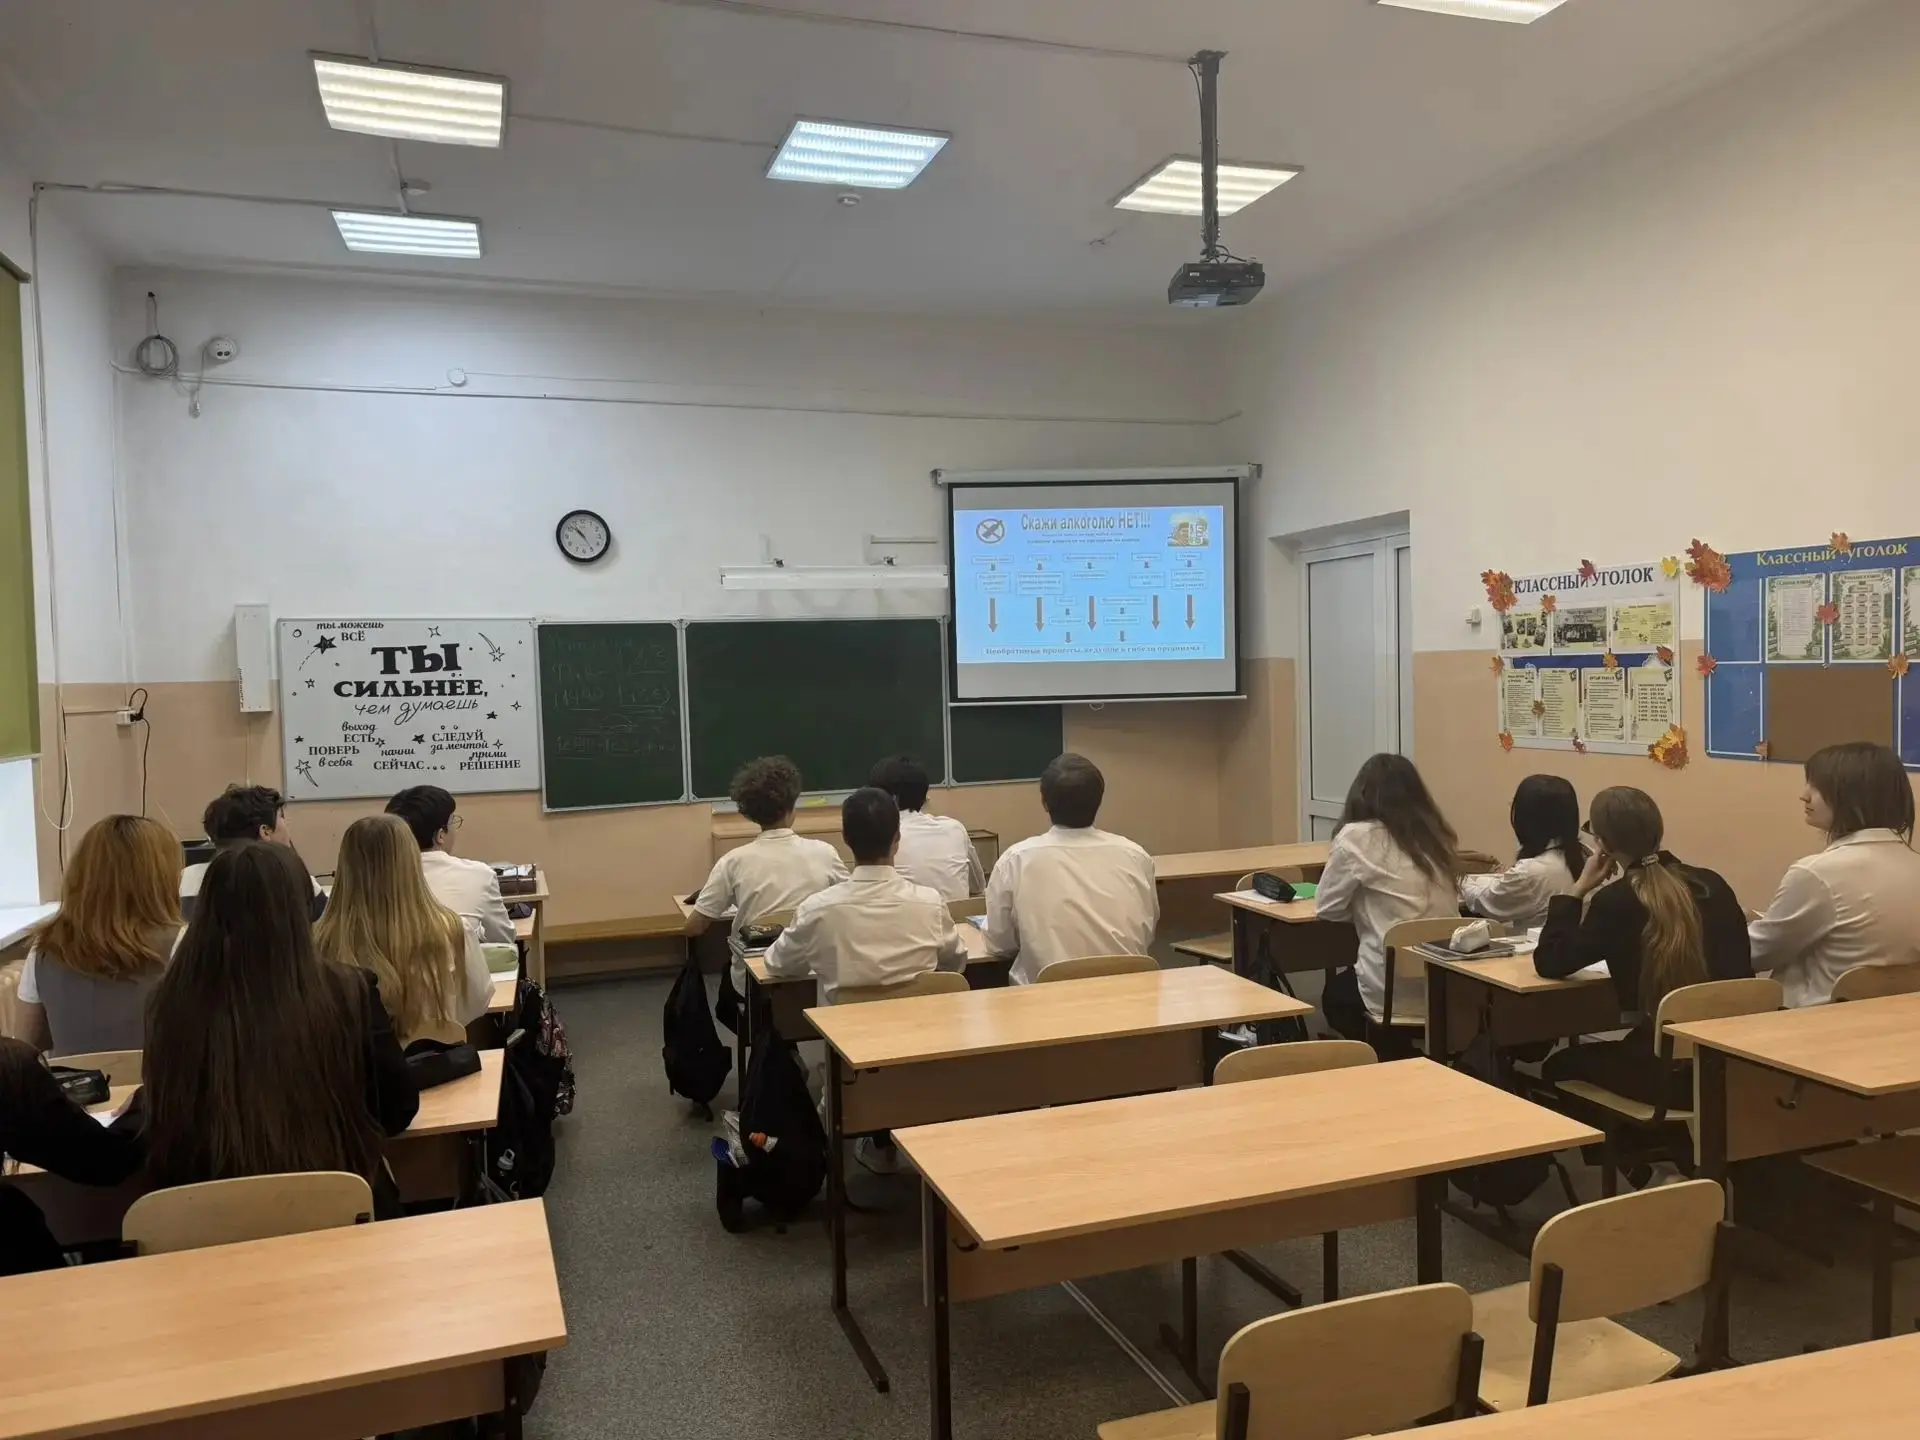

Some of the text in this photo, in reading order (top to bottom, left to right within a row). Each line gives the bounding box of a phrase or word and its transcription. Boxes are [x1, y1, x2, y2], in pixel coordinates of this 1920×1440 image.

[1021, 510, 1151, 531] Скажи алкоголю НЕТ!!!
[1756, 543, 1908, 567] Классный уголок
[1592, 567, 1654, 587] УГОЛОК
[338, 621, 384, 629] можешь
[341, 631, 365, 641] ВСЁ
[371, 643, 462, 675] ТЫ
[354, 699, 479, 726] чем думаешь
[342, 722, 377, 734] выход
[344, 732, 375, 743] ЕСТЬ
[432, 731, 483, 742] СЛЕДУЙ
[309, 746, 360, 756] ПОВЕРЬ
[381, 747, 416, 757] начни
[431, 740, 489, 754] за мечтой
[469, 750, 507, 760] прими
[319, 757, 353, 767] в себя
[459, 760, 521, 771] РЕШЕНИЕ
